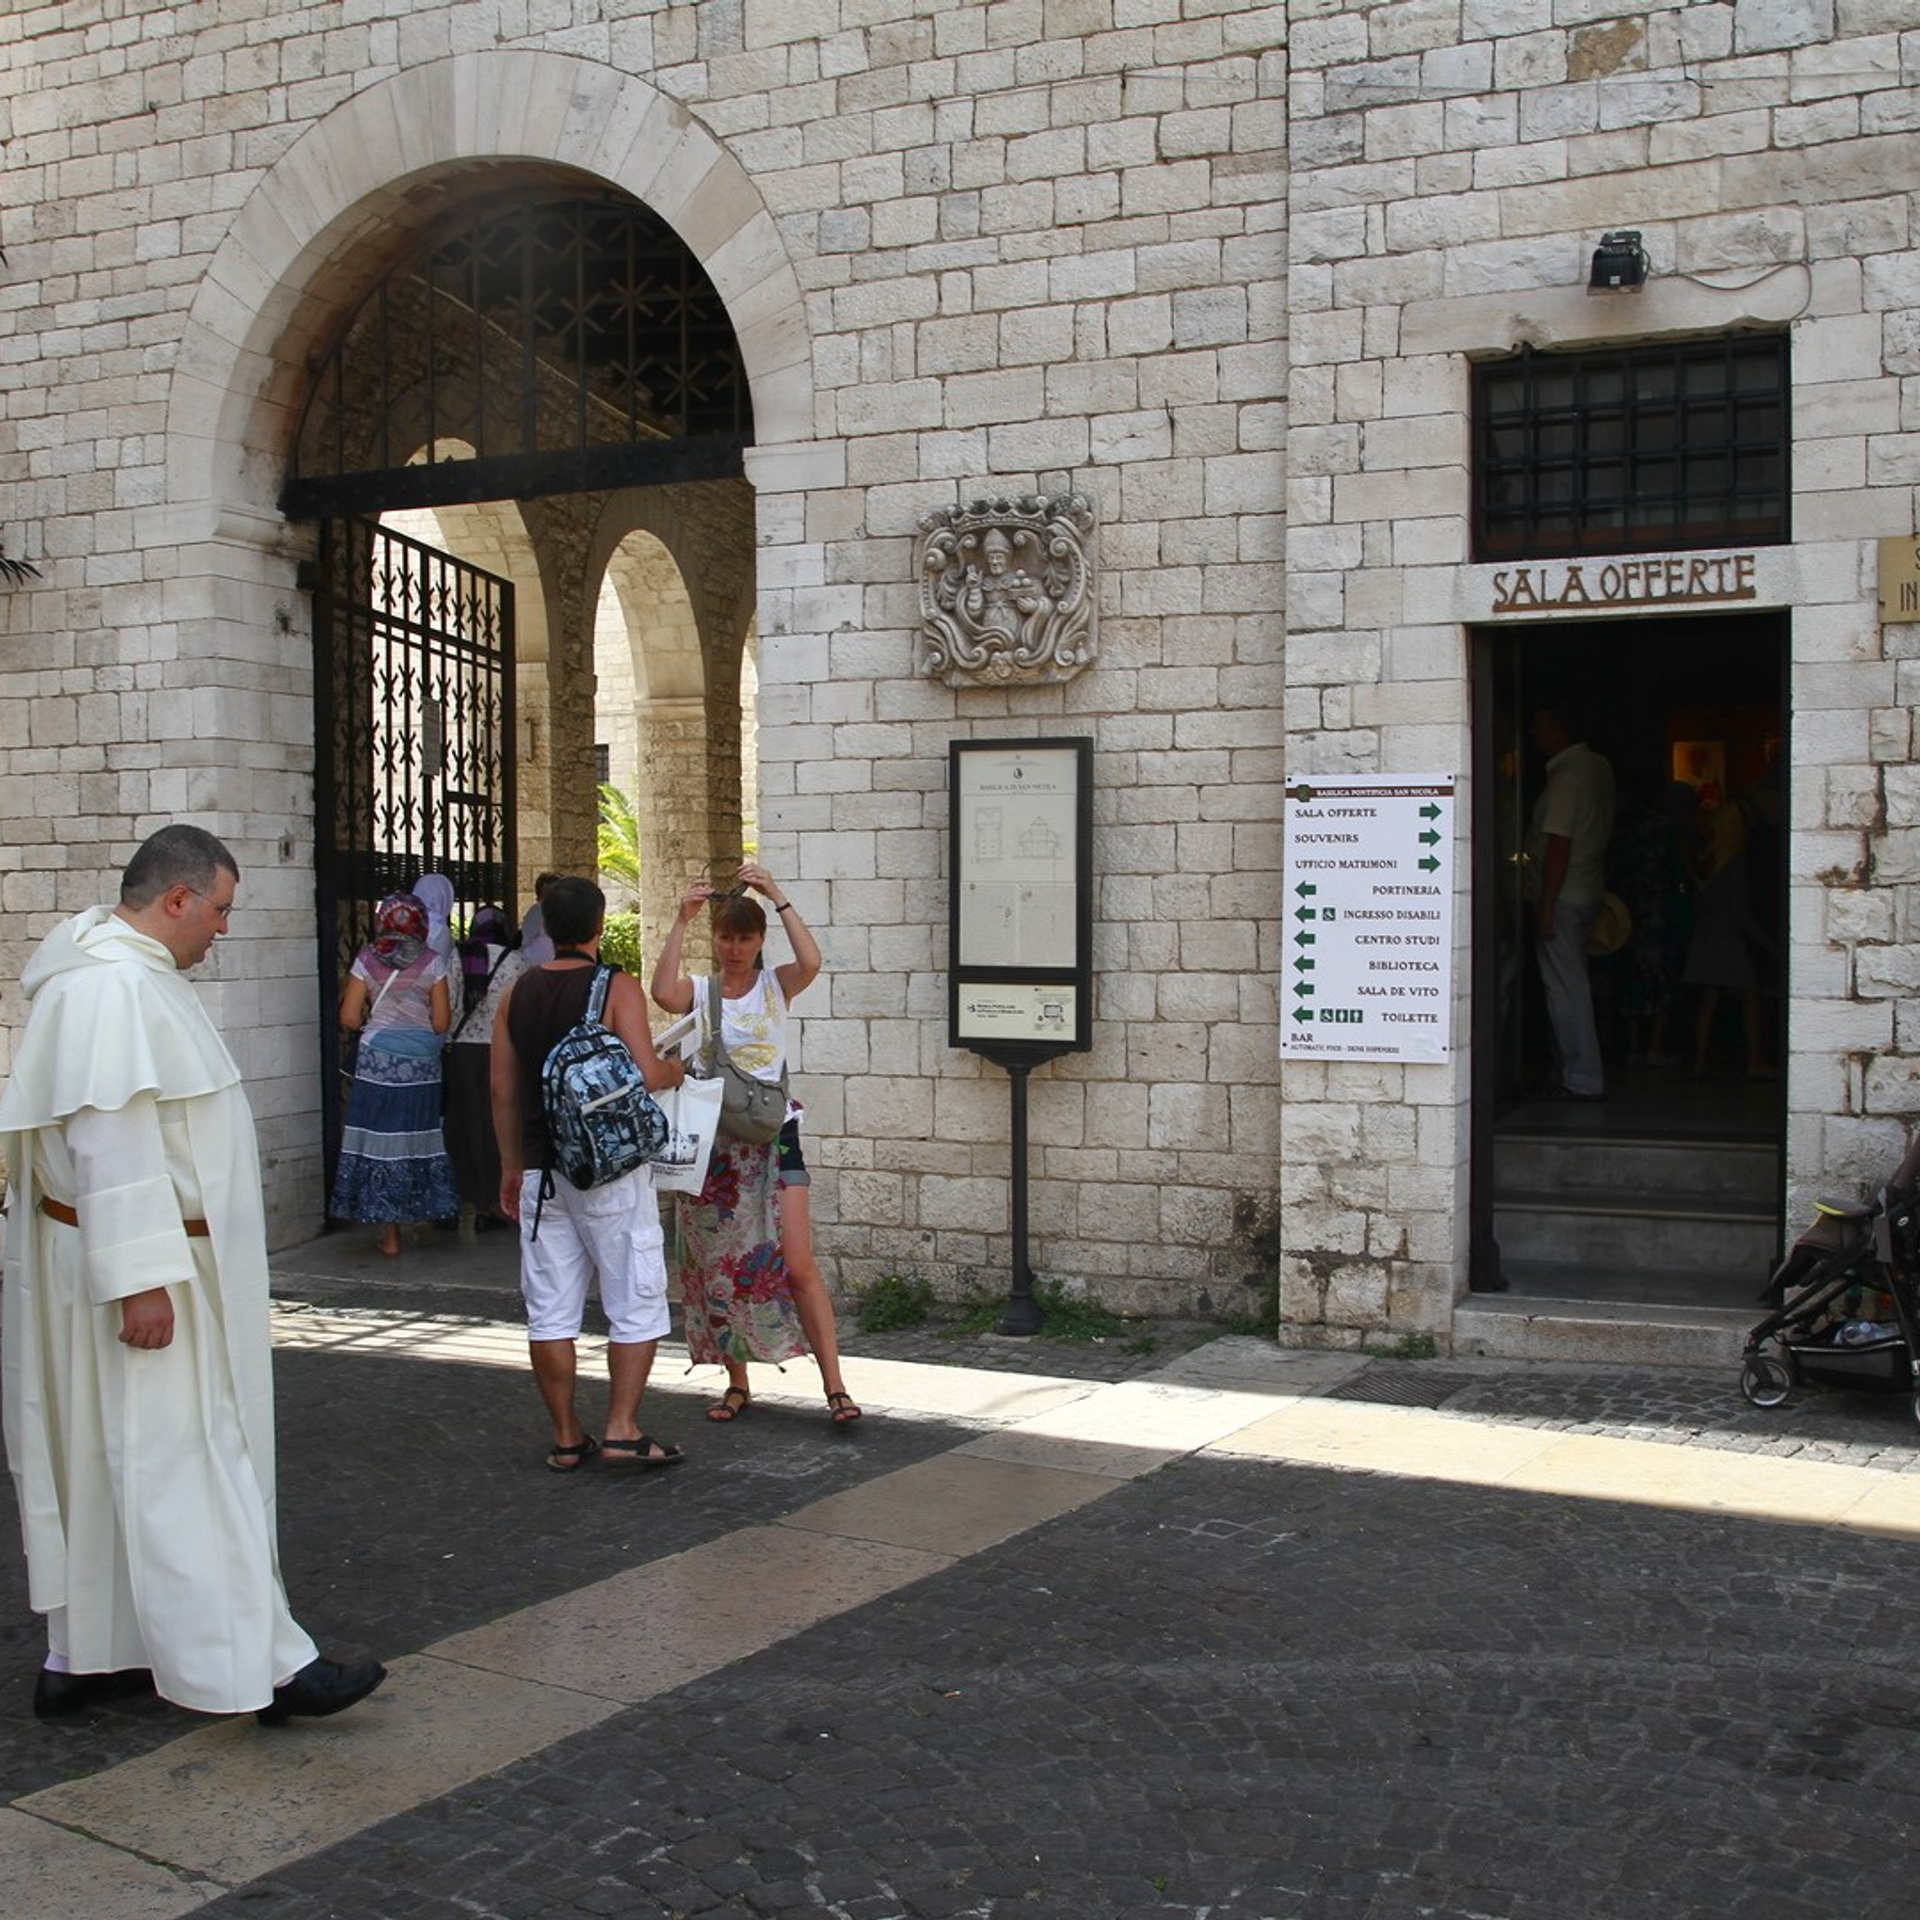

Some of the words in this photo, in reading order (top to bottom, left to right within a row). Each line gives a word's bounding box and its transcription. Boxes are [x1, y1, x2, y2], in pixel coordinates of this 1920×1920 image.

[1493, 566, 1591, 607] SALA
[1599, 555, 1755, 602] OFFERTE
[1316, 789, 1350, 797] BASILICA
[1351, 788, 1393, 796] PONTIFICIA
[1394, 788, 1409, 796] SAN
[1410, 788, 1440, 796] NICOLA
[1295, 809, 1325, 818] SALA
[1327, 809, 1377, 818] OFFERTE
[1294, 834, 1359, 844] SOUVENIRS
[1295, 859, 1336, 869] UFFICIO
[1338, 859, 1398, 869] MATRIMONI
[1372, 886, 1441, 896] PORTINERIA
[1343, 910, 1394, 920] INGRESSO
[1396, 910, 1441, 920] DISABILI
[1355, 936, 1402, 945] CENTRO
[1404, 936, 1440, 945] STUDI
[1369, 961, 1440, 971] BIBLIOTECA
[1357, 986, 1387, 996] SALA
[1390, 987, 1406, 996] DE
[1409, 987, 1439, 997] VITO
[1381, 1013, 1438, 1023] TOILETTE
[1291, 1033, 1313, 1043] BAR
